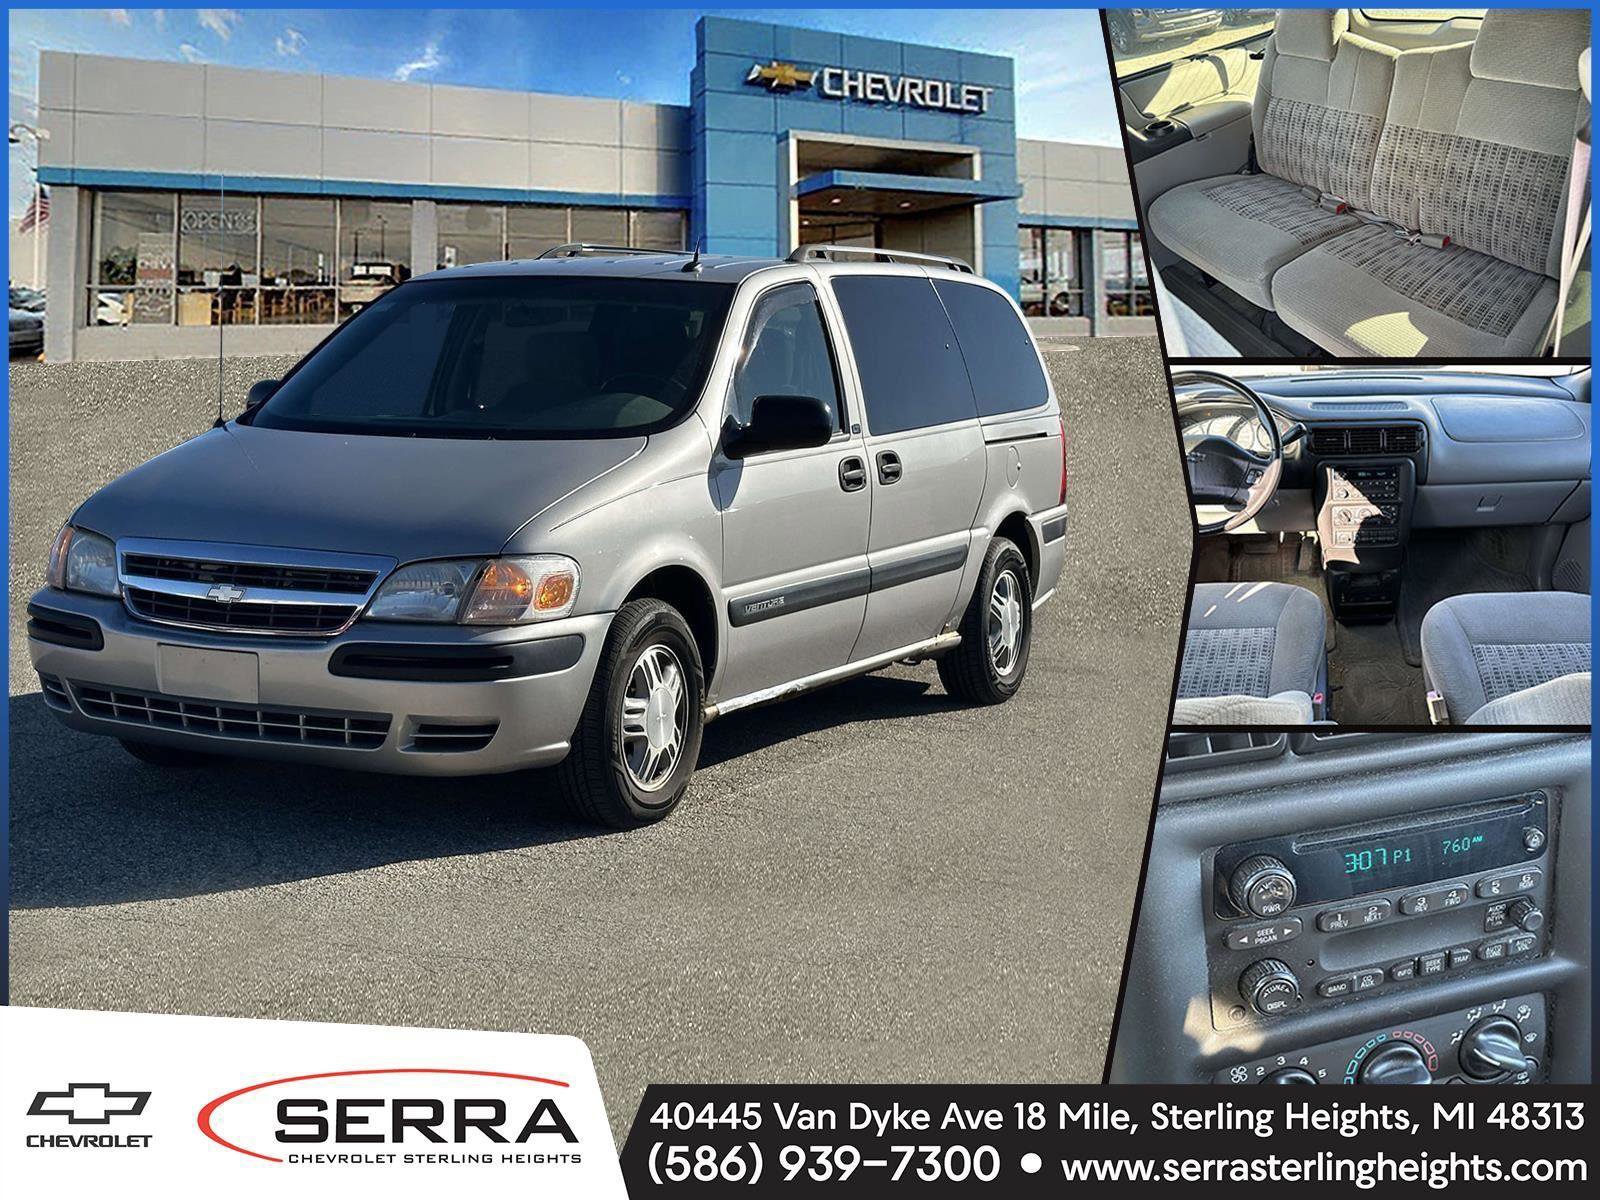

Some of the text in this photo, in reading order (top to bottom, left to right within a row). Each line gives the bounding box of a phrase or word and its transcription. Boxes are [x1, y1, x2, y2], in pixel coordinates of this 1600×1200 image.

[822, 67, 994, 112] CHEVROLET
[1443, 838, 1471, 854] 760
[1262, 904, 1281, 913] PWR
[1256, 927, 1275, 938] SEEK
[1265, 983, 1286, 995] TUNE
[1327, 983, 1347, 994] BAND
[1276, 1055, 1287, 1066] 3
[1299, 1055, 1309, 1066] 4
[1255, 1066, 1266, 1076] 2
[1317, 1068, 1328, 1079] 5
